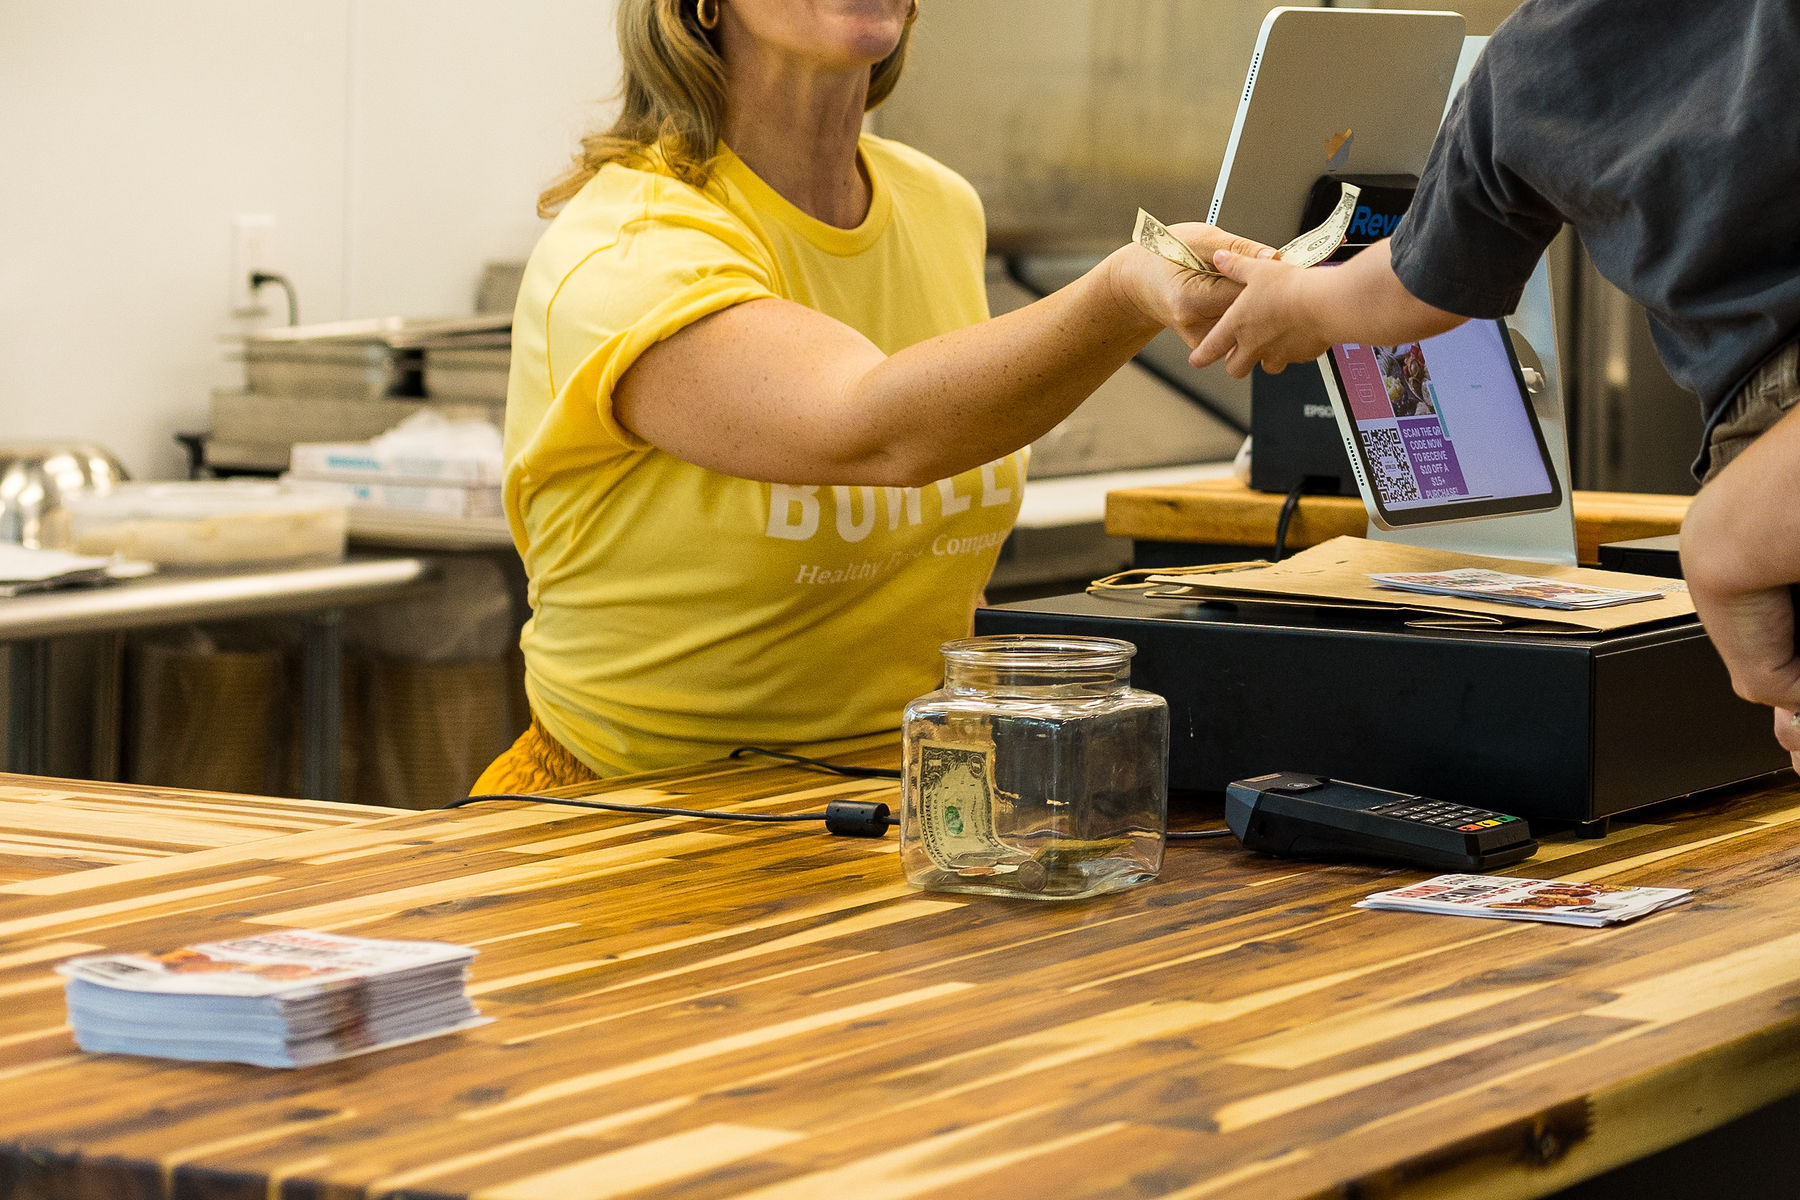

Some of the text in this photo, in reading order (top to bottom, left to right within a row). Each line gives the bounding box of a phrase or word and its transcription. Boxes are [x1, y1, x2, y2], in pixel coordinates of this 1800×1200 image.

[1402, 426, 1443, 438] SCAN THE QR
[1410, 438, 1443, 450] CODE NOW
[1413, 450, 1448, 462] TO RECEIVE
[1420, 463, 1449, 475] $10 OFF A
